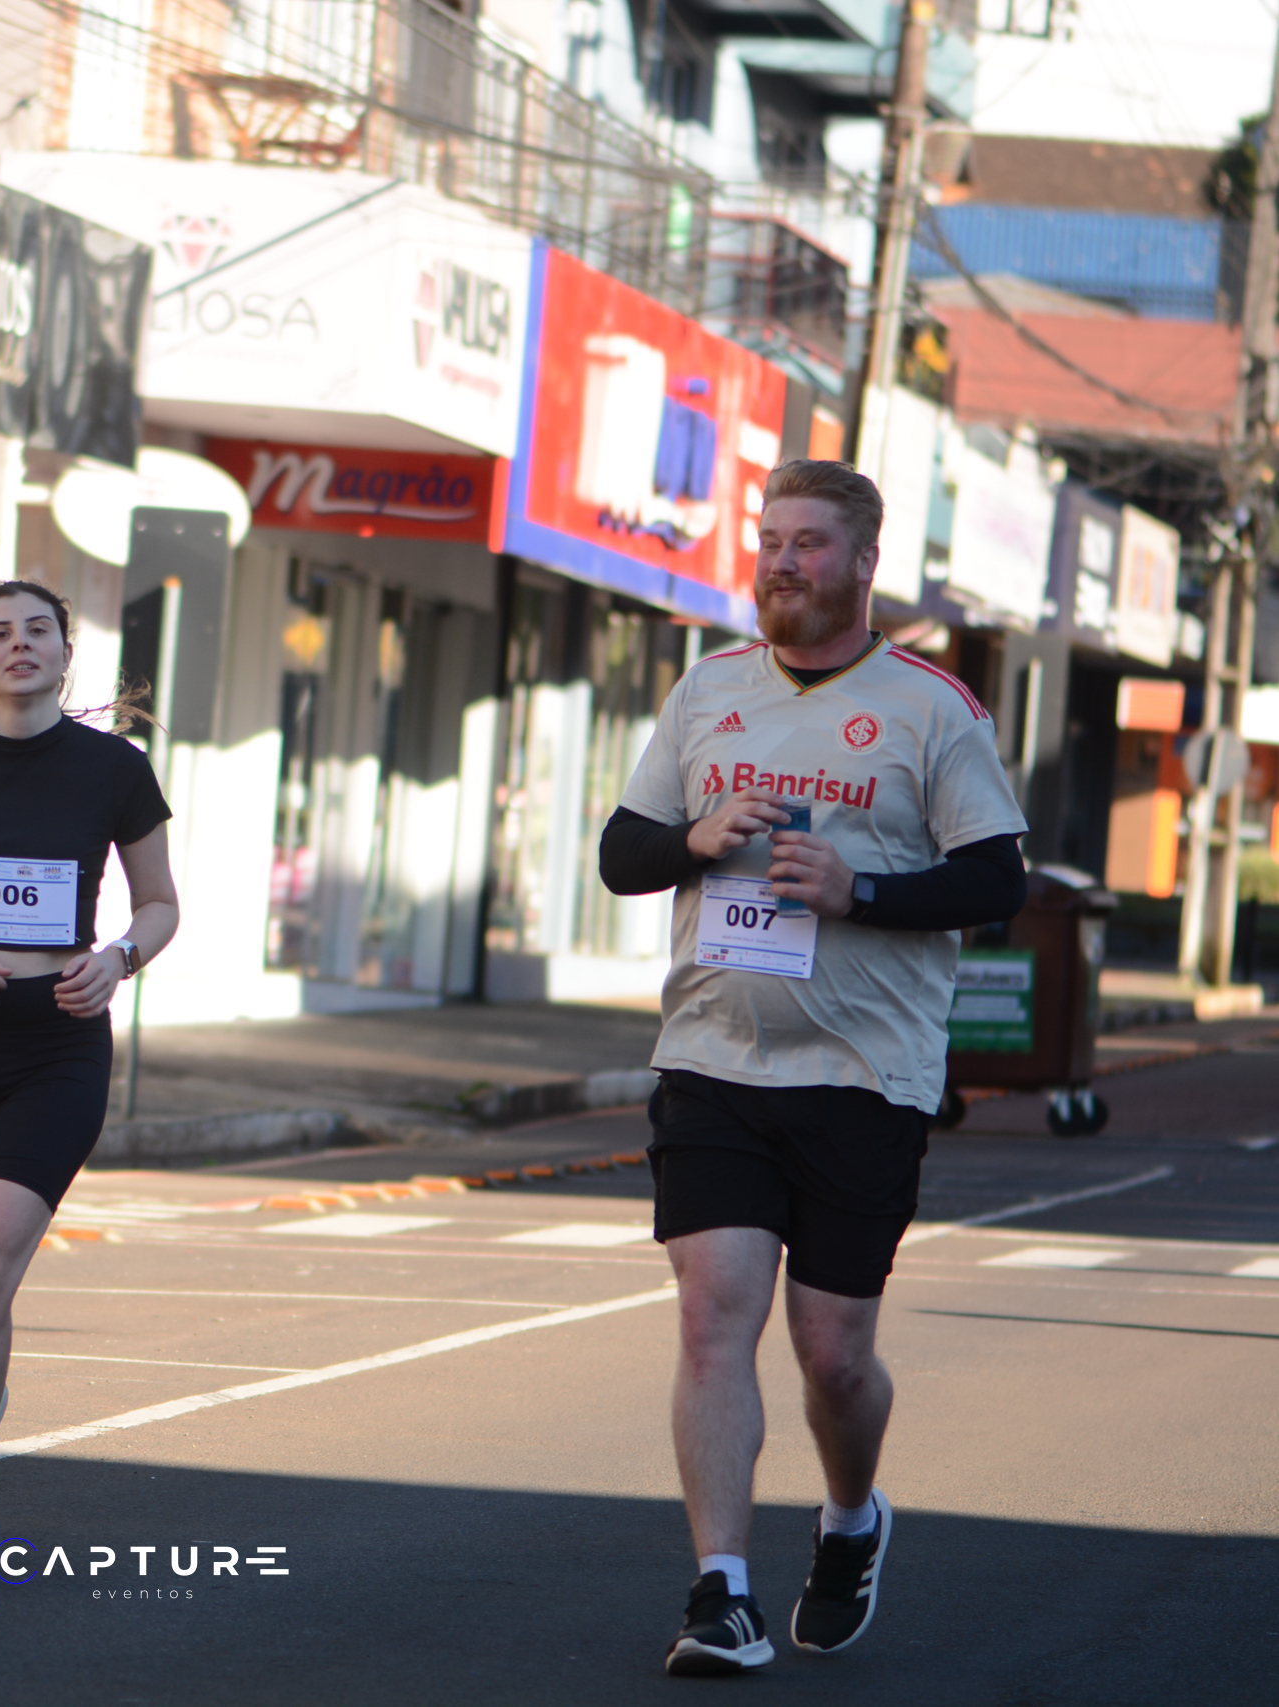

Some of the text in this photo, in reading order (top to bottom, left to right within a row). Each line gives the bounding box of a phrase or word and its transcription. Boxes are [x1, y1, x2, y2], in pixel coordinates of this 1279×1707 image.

[247, 451, 477, 521] Magrão
[713, 724, 746, 733] adidas
[732, 762, 877, 810] Banrisul
[726, 904, 778, 931] 007
